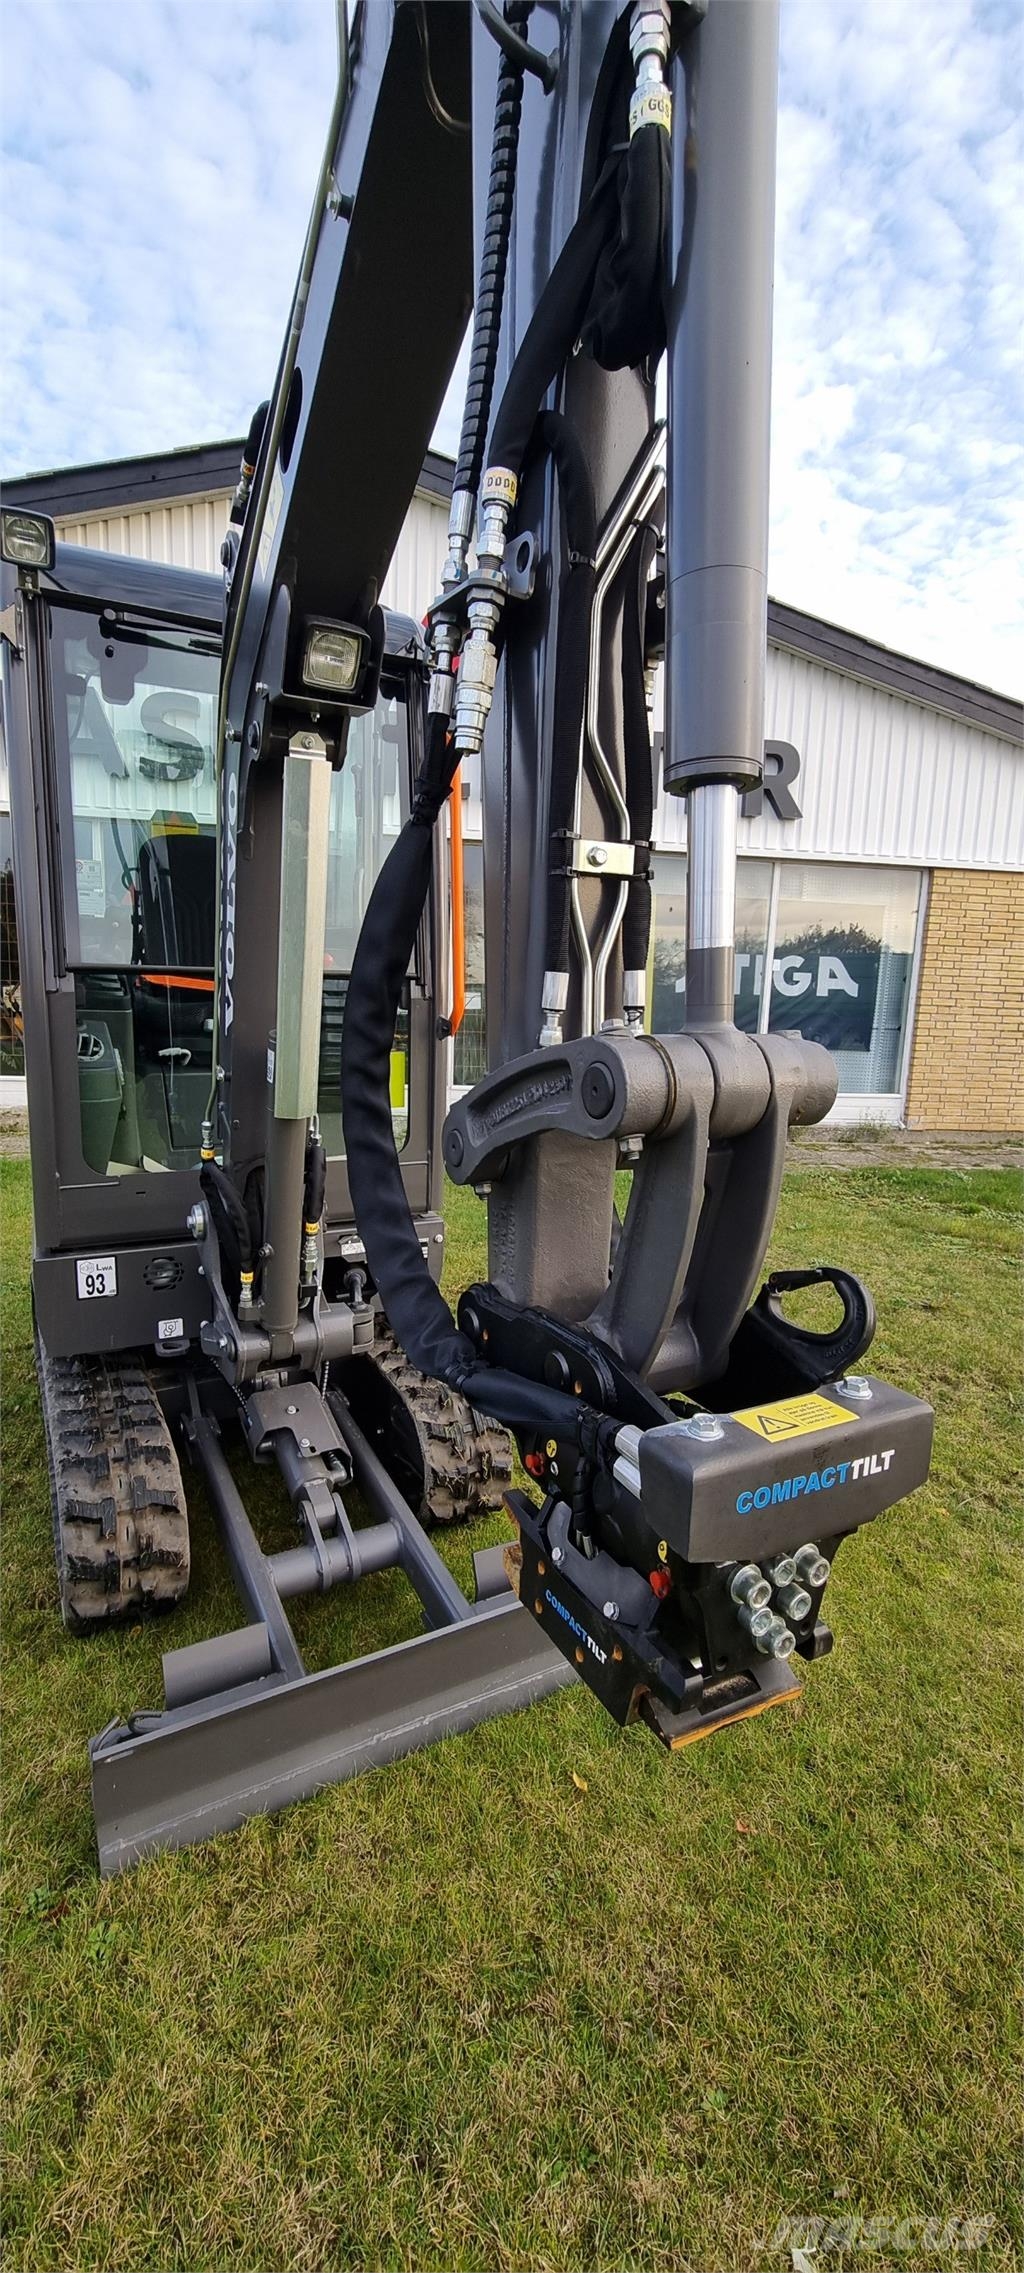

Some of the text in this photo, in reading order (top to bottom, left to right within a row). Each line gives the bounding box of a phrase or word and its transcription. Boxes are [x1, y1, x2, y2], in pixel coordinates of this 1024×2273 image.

[675, 953, 859, 997] TIGA
[85, 1273, 106, 1296] 93
[736, 1449, 895, 1514] COMPACTTILT
